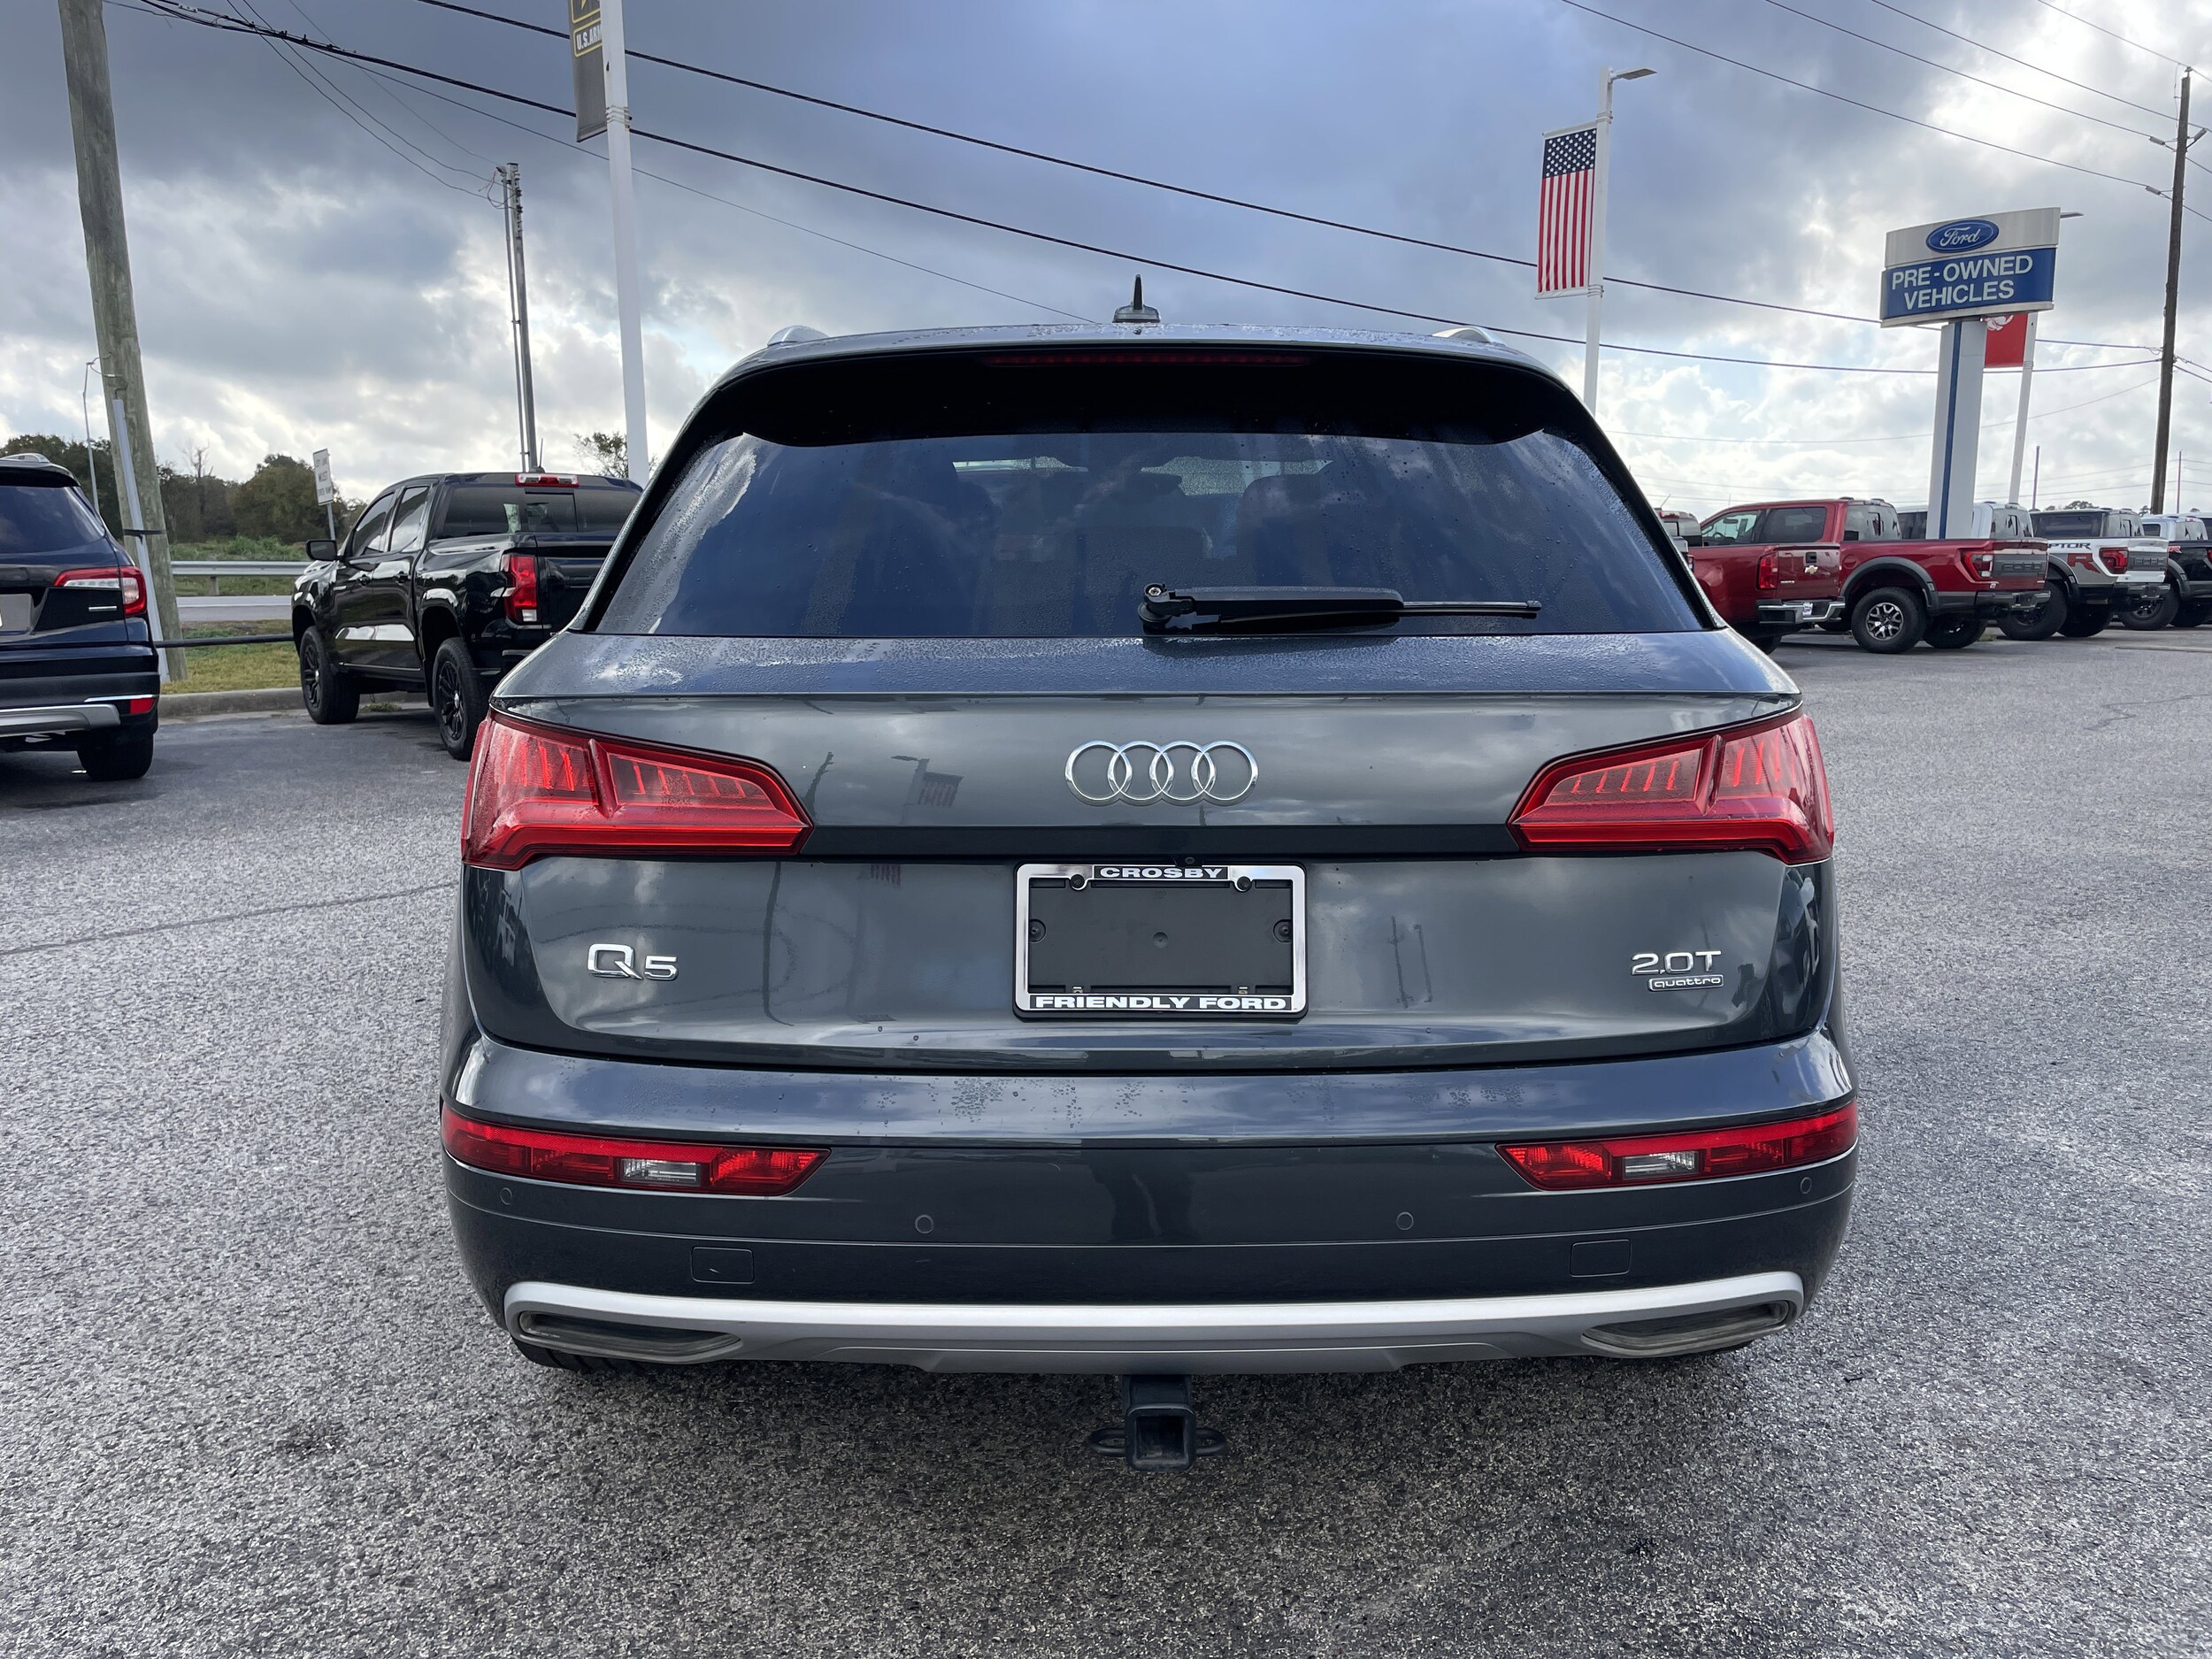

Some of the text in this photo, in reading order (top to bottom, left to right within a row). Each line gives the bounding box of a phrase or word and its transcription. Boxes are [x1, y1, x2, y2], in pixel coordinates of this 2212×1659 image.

[1939, 226, 1981, 247] Ford
[1892, 255, 2033, 290] PRE-OWNED
[1904, 280, 2015, 310] VEHICLES
[1100, 867, 1223, 879] CROSBY
[588, 943, 679, 980] Q5
[1632, 950, 1722, 975] 2.0T
[1654, 977, 1721, 988] quattro
[1034, 995, 1286, 1010] FRIENDLY FORD
